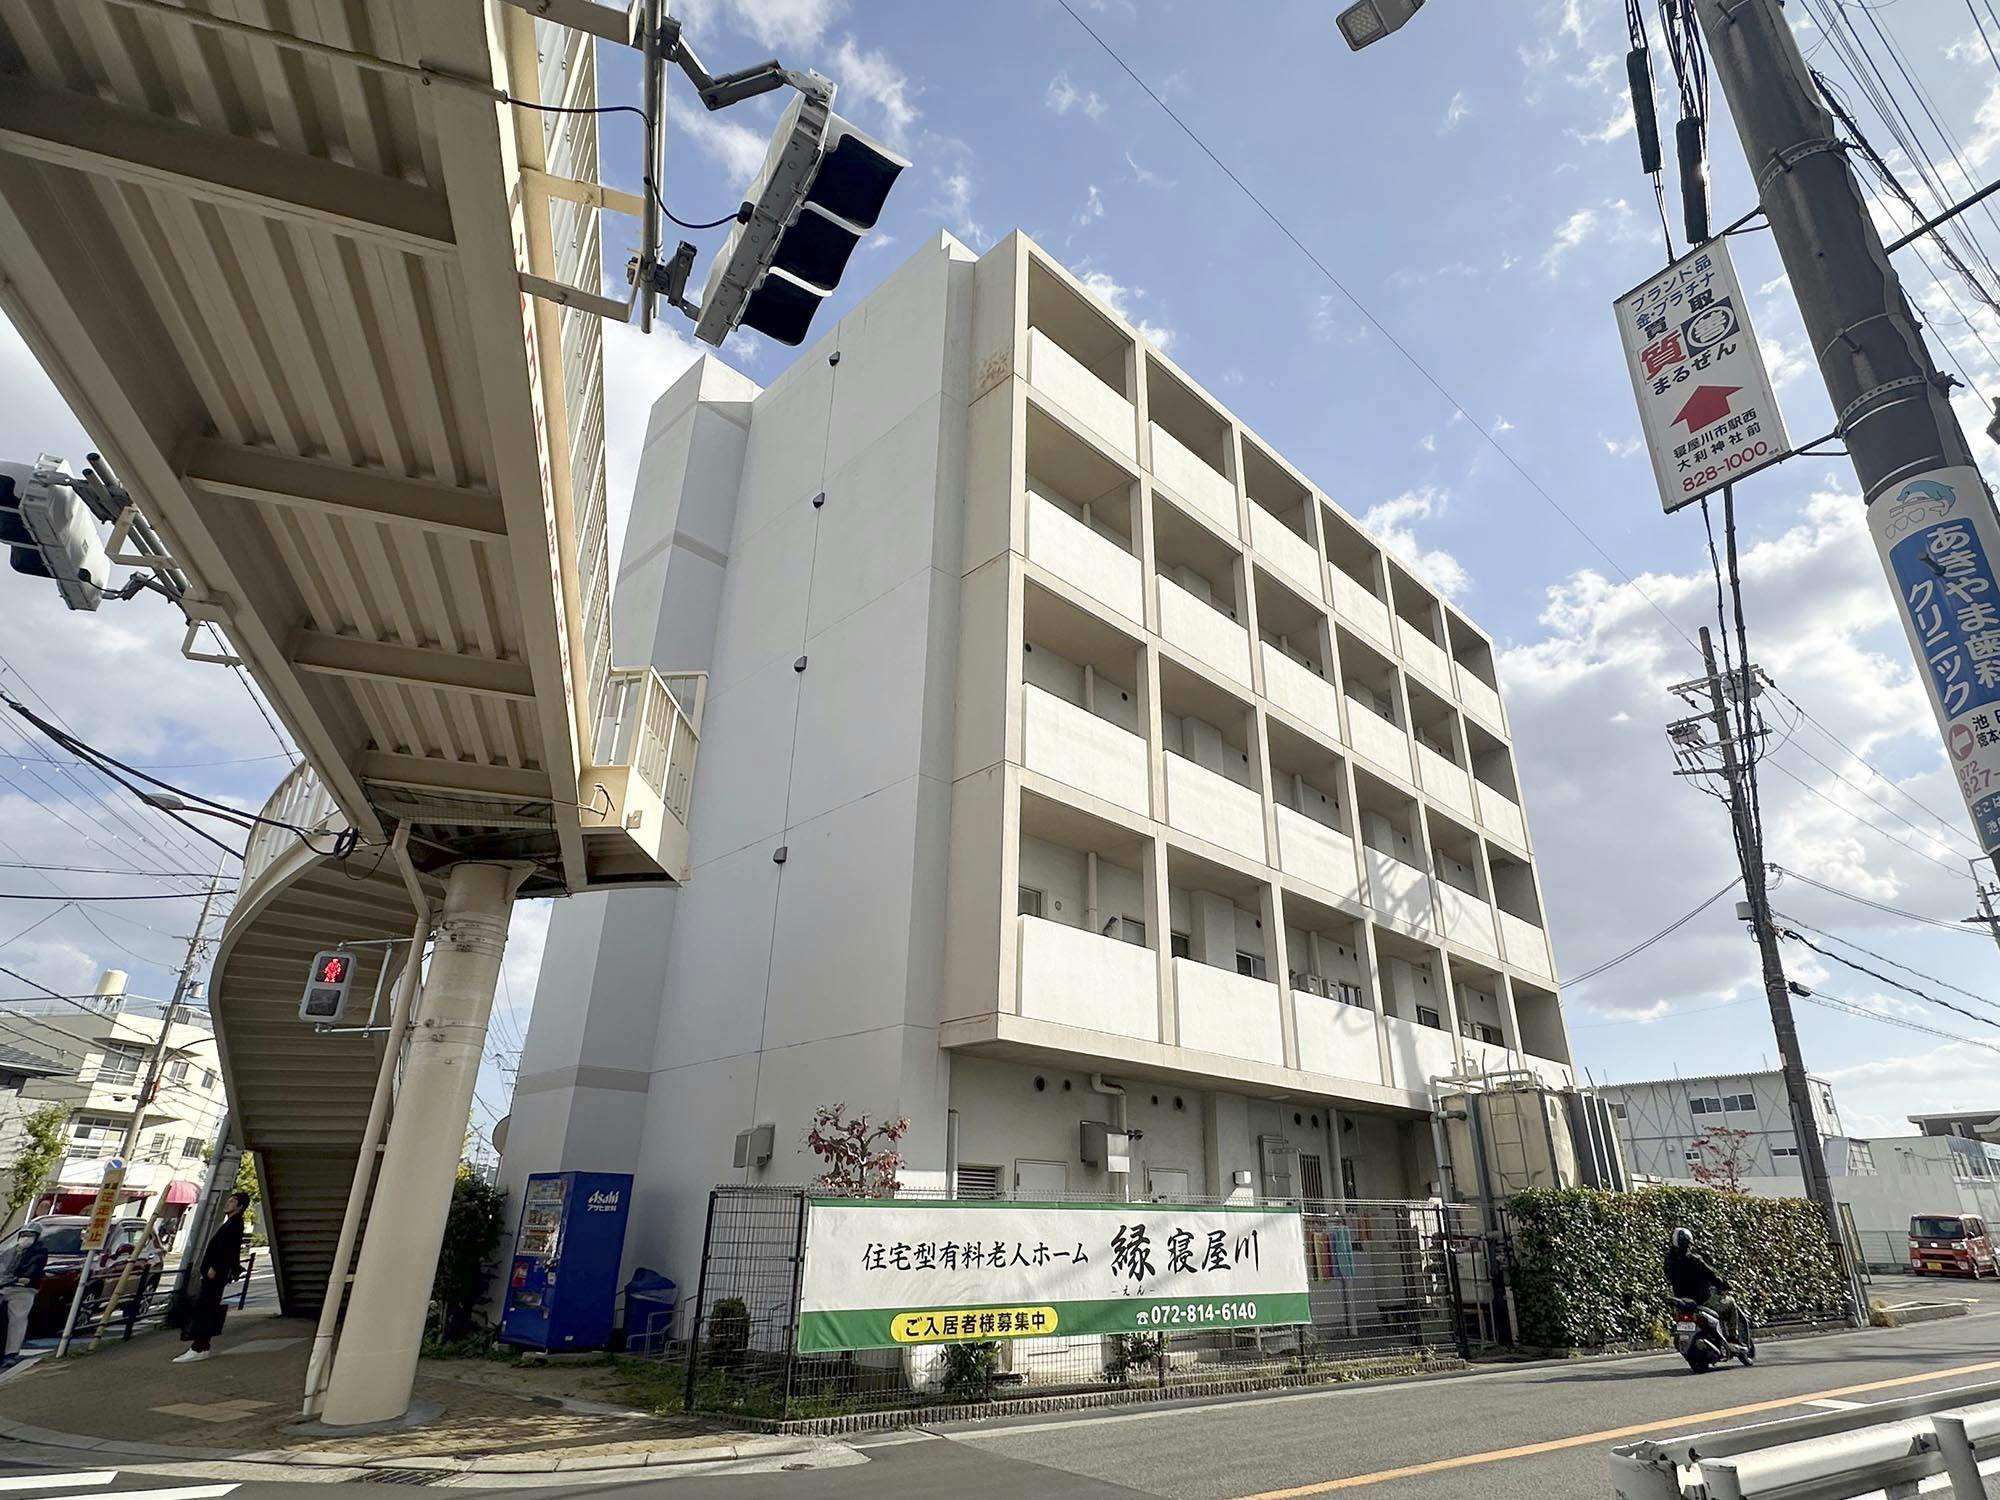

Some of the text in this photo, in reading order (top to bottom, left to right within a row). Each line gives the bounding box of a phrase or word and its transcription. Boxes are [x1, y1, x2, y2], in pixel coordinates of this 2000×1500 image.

[1631, 253, 1713, 312] ブランド品
[1641, 329, 1688, 382] 質
[1652, 342, 1737, 396] まるぜん
[1673, 407, 1758, 460] 寝屋川市駅西
[1677, 421, 1762, 473] 大利神社前
[1682, 441, 1768, 492] 828-1000
[1908, 579, 1971, 715] クリニック
[1959, 760, 1980, 781] 072
[588, 1190, 620, 1204] Asahi
[862, 1223, 1260, 1282] 住宅型有料老人ホーム 縁 寝屋川
[905, 1311, 1046, 1337] ご入居者様募集中
[1151, 1302, 1257, 1325] 072-814-6140
